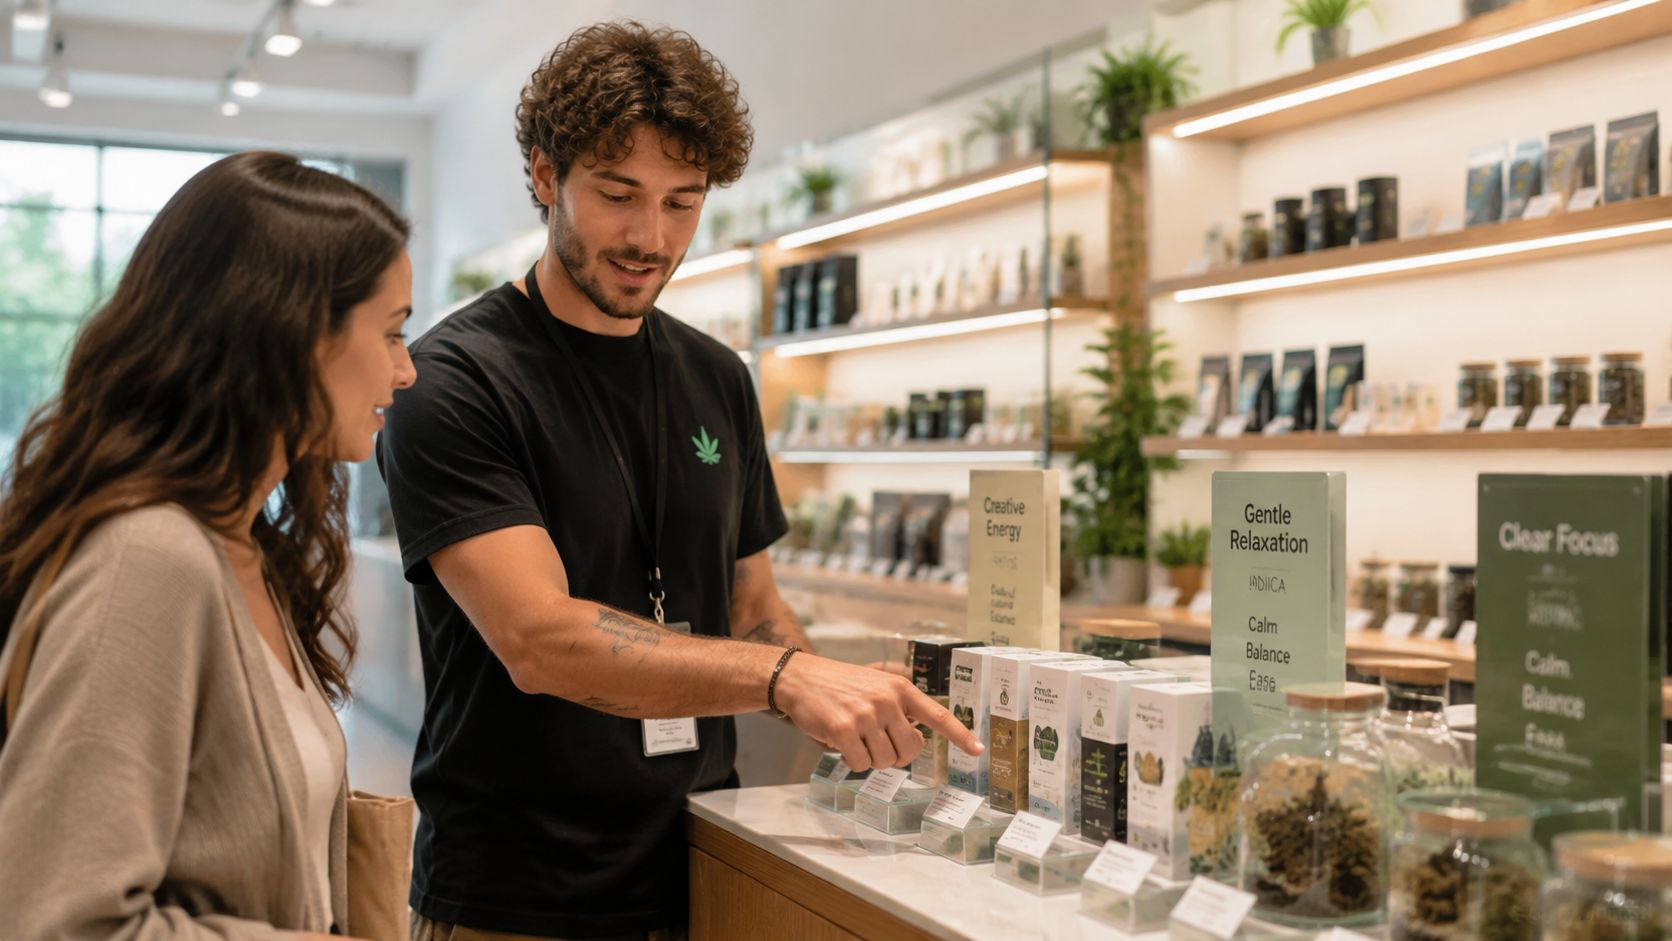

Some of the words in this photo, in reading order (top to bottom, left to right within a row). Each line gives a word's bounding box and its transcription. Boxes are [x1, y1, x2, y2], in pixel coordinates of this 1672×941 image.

[984, 497, 1025, 515] Creative
[1244, 503, 1291, 525] Gentle
[987, 520, 1022, 542] Energy
[1230, 529, 1308, 554] Relaxation
[1498, 521, 1553, 553] Clear
[1556, 523, 1620, 557] Focus
[1248, 616, 1278, 634] Calm
[1246, 641, 1291, 664] Balance
